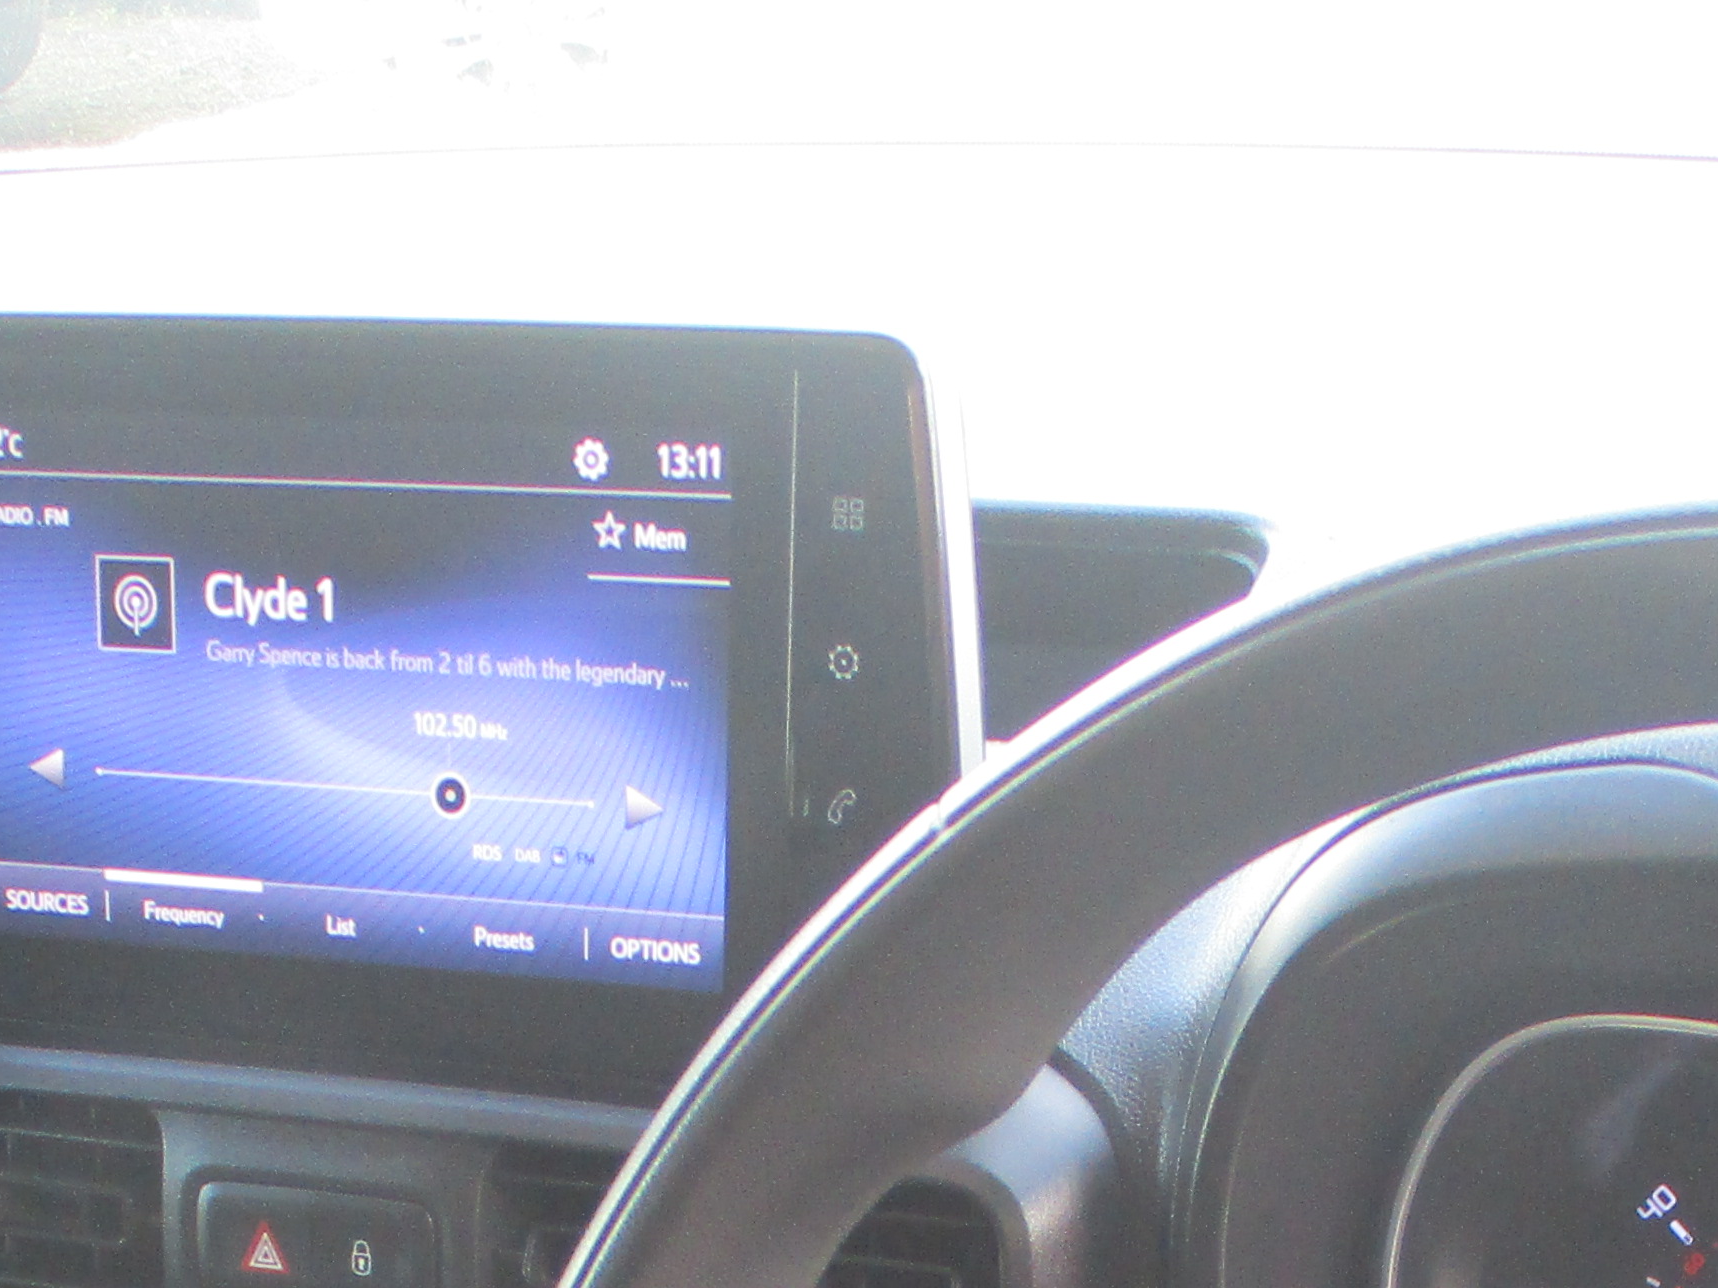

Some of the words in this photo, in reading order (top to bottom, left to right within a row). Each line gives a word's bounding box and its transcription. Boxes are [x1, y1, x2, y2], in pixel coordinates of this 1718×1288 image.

[656, 441, 723, 481] 13:11
[43, 505, 70, 527] FM
[633, 521, 688, 551] Mem
[204, 570, 308, 626] Clyde
[315, 576, 334, 623] 1
[206, 639, 255, 666] Garry
[259, 642, 322, 670] Spence
[325, 648, 340, 669] is
[343, 648, 386, 672] back
[390, 650, 434, 674] from
[438, 651, 452, 675] 2
[456, 653, 474, 677] til
[478, 654, 493, 677] 6
[496, 657, 538, 680] with
[541, 659, 571, 682] the
[575, 660, 667, 691] legendary
[413, 711, 477, 739] 102.50
[473, 844, 502, 862] RDS
[514, 847, 540, 864] DAB
[4, 888, 90, 916] SOURCES
[143, 899, 225, 929] Frequency
[325, 913, 357, 938] List
[473, 925, 535, 952] Presets
[609, 935, 703, 966] OPTIONS
[1636, 1184, 1677, 1220] 40
